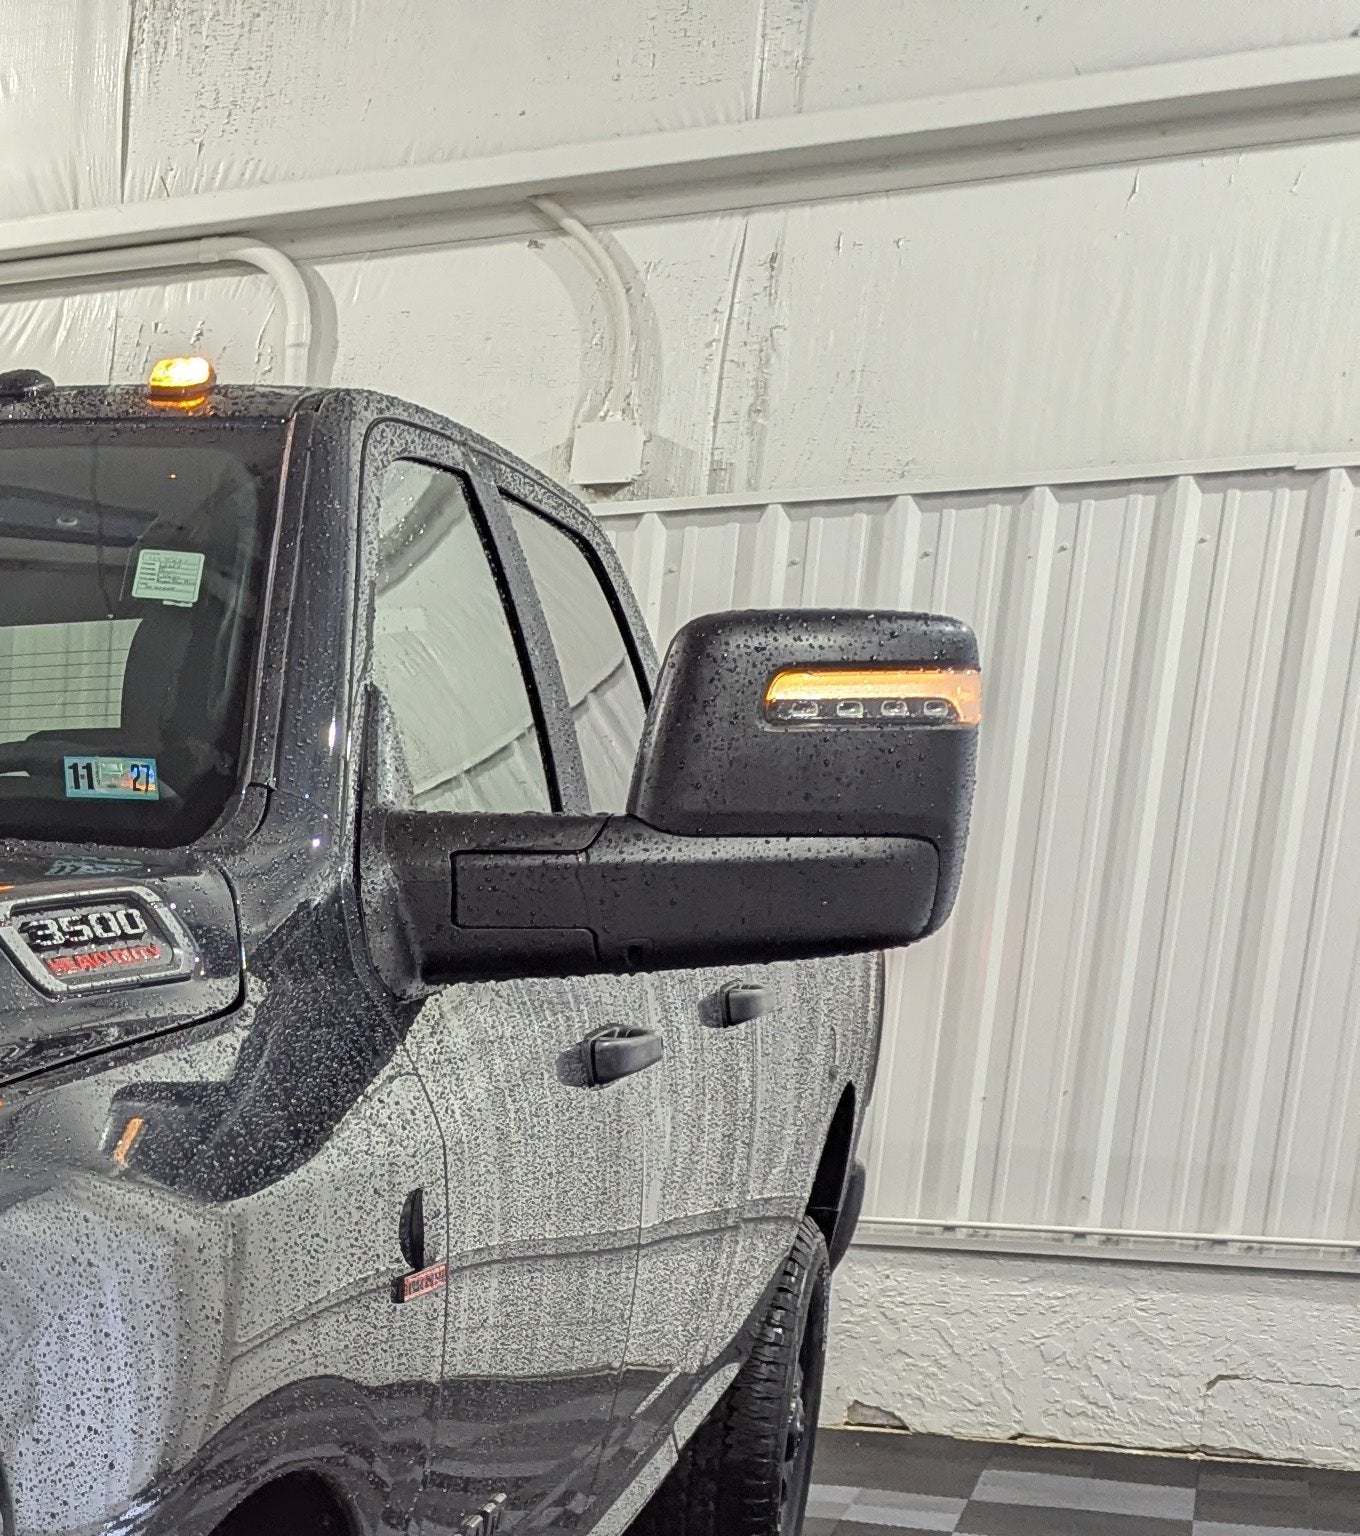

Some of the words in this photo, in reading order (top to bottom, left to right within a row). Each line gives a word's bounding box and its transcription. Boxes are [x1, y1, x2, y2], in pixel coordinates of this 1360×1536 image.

[67, 762, 95, 790] 11
[130, 763, 151, 794] 27
[20, 908, 148, 947] 3500
